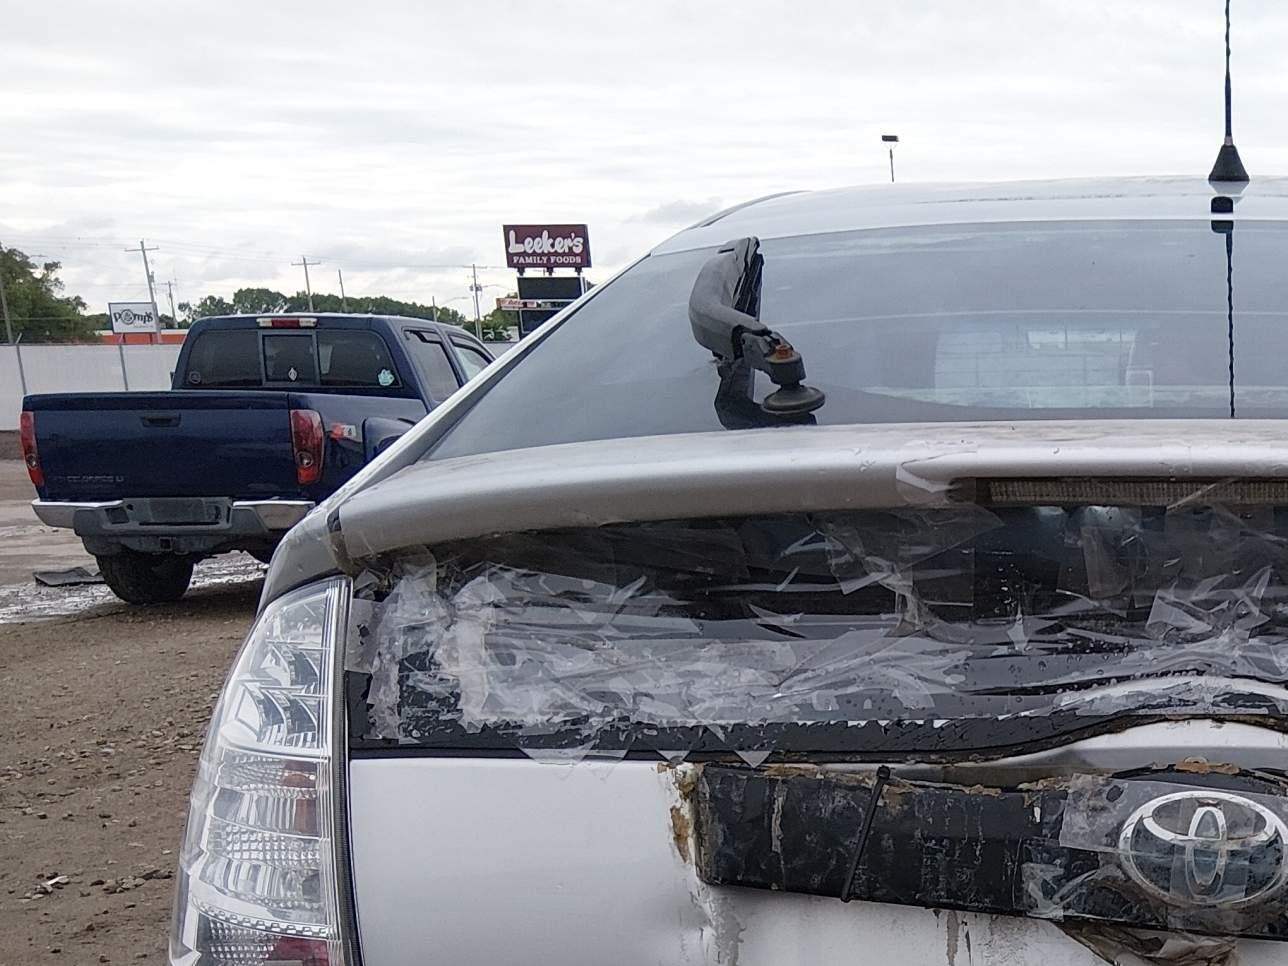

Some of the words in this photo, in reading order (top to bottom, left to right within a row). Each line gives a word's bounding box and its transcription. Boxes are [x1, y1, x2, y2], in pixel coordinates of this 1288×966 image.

[508, 229, 584, 254] Leeker's
[512, 256, 547, 264] FAMILY
[550, 256, 582, 264] FOODS
